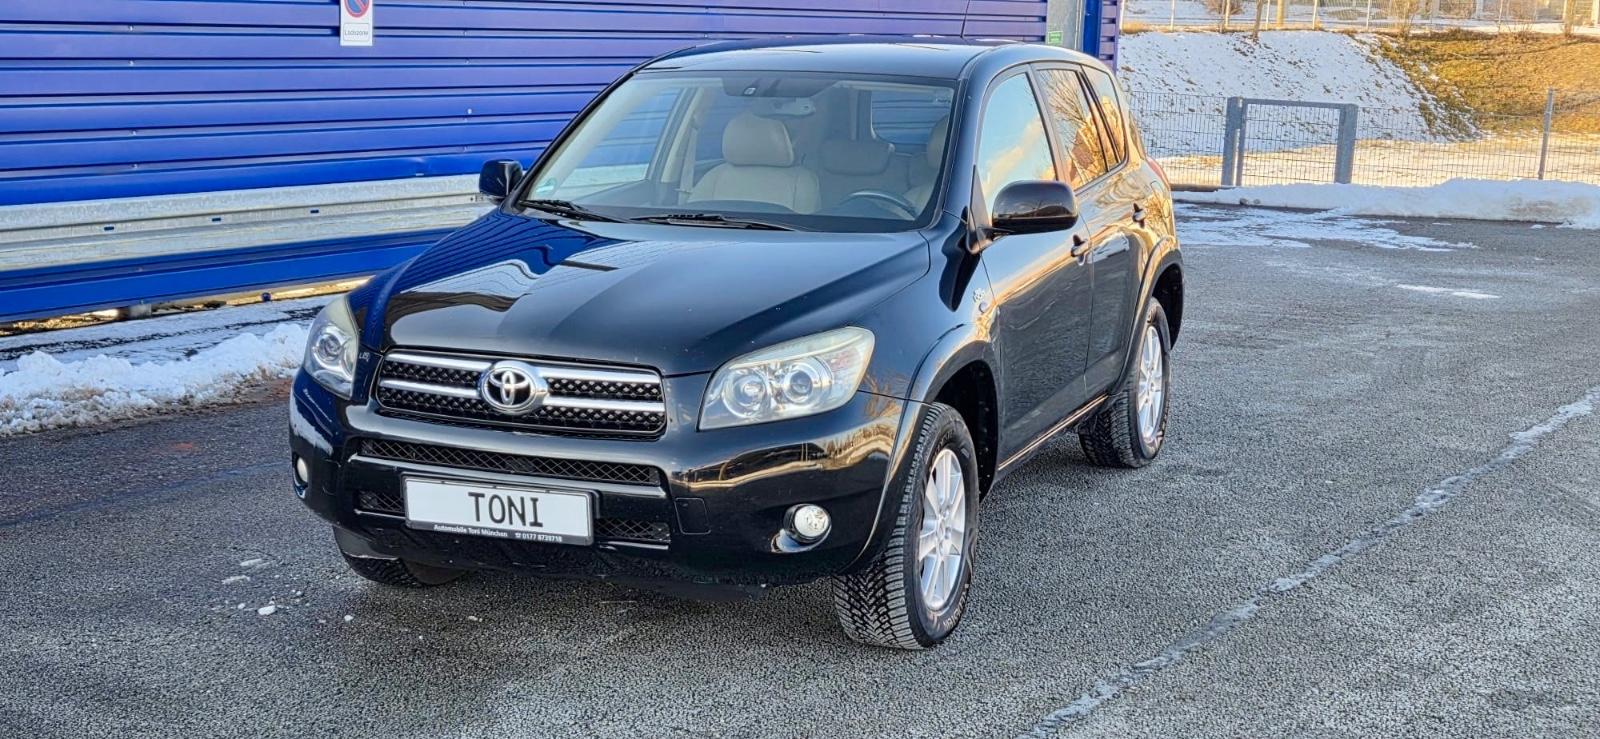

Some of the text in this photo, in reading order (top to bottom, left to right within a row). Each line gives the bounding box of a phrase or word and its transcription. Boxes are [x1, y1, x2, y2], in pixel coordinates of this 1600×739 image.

[468, 491, 544, 528] TONI
[433, 524, 467, 534] Automobile
[468, 527, 481, 535] Toni
[481, 528, 508, 538] München
[522, 532, 537, 541] 0177
